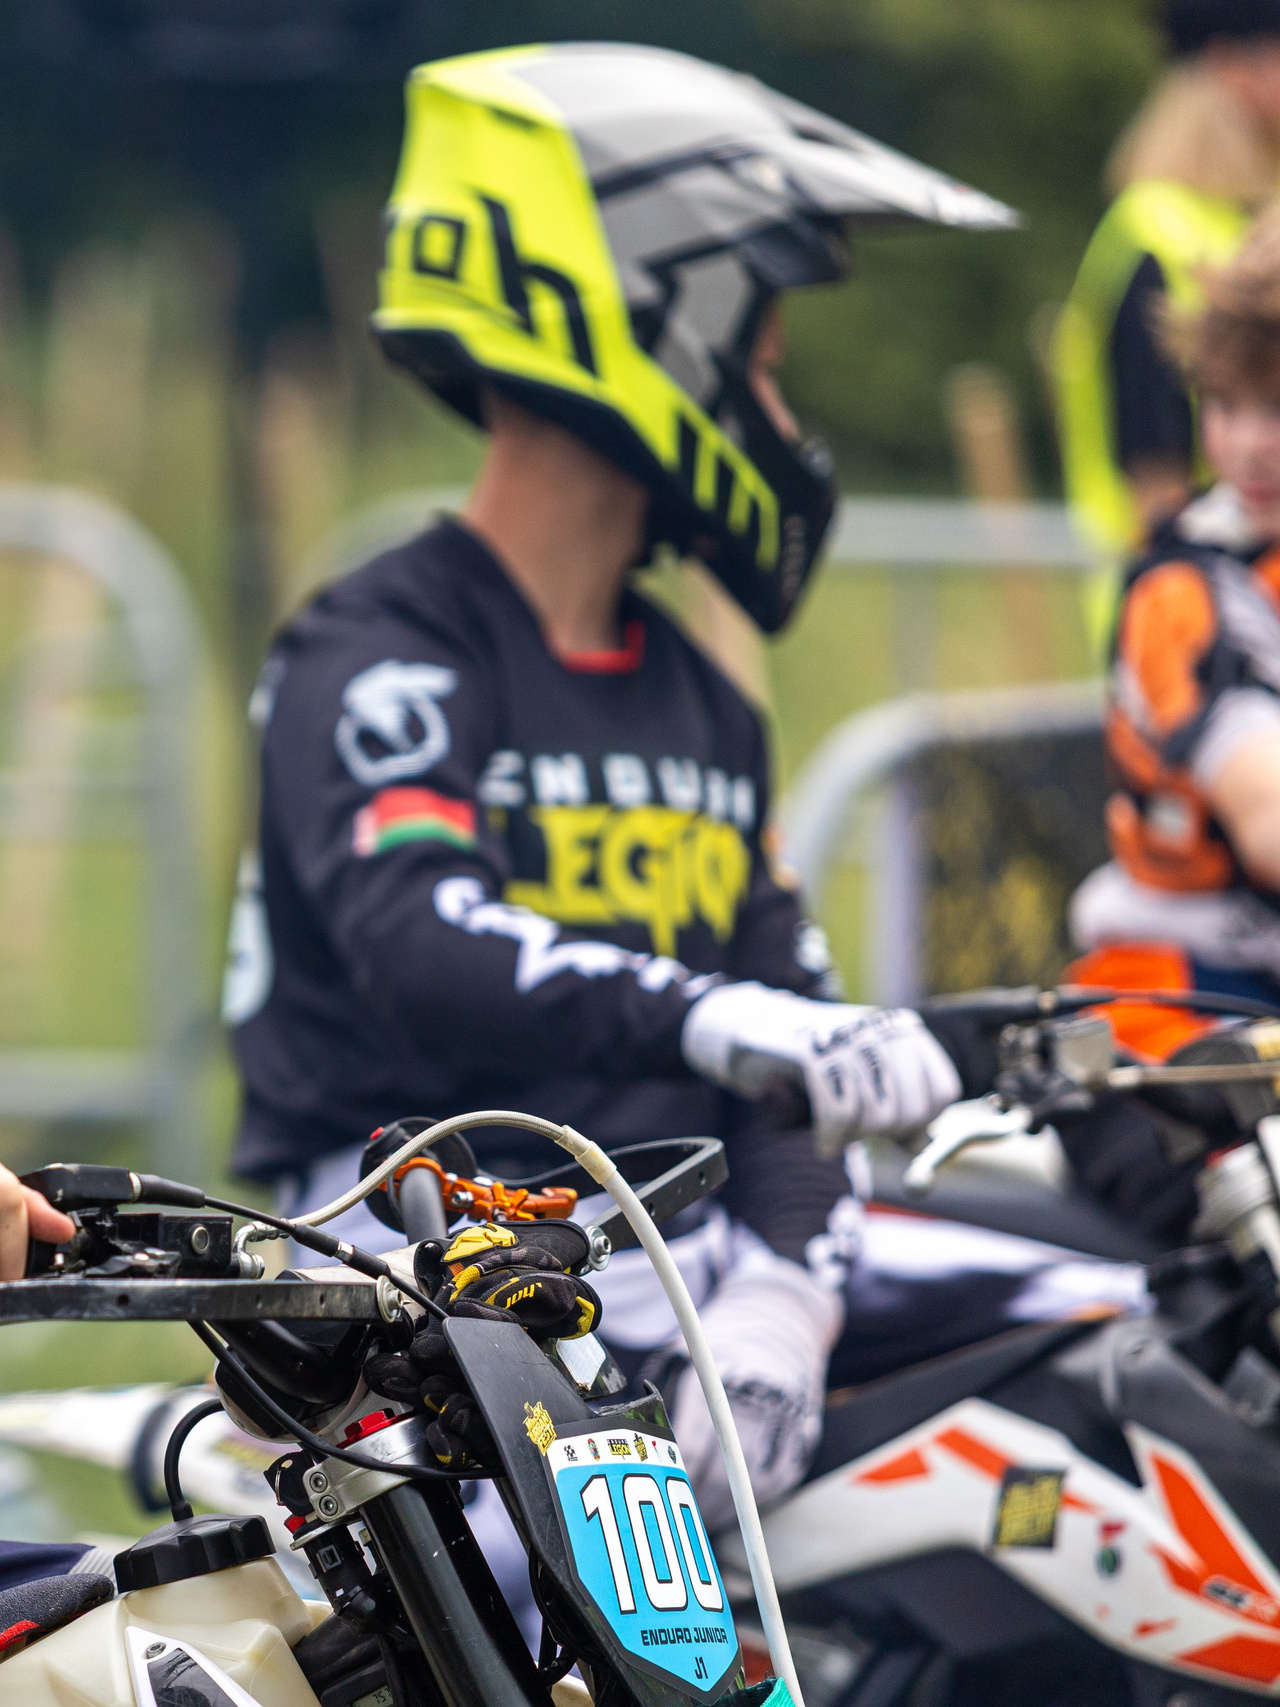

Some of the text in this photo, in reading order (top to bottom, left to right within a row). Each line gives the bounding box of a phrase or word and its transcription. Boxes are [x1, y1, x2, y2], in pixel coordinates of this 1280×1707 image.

[579, 1473, 724, 1614] 100
[641, 1627, 729, 1646] ENDURO JUNIOR
[694, 1656, 708, 1680] J1
